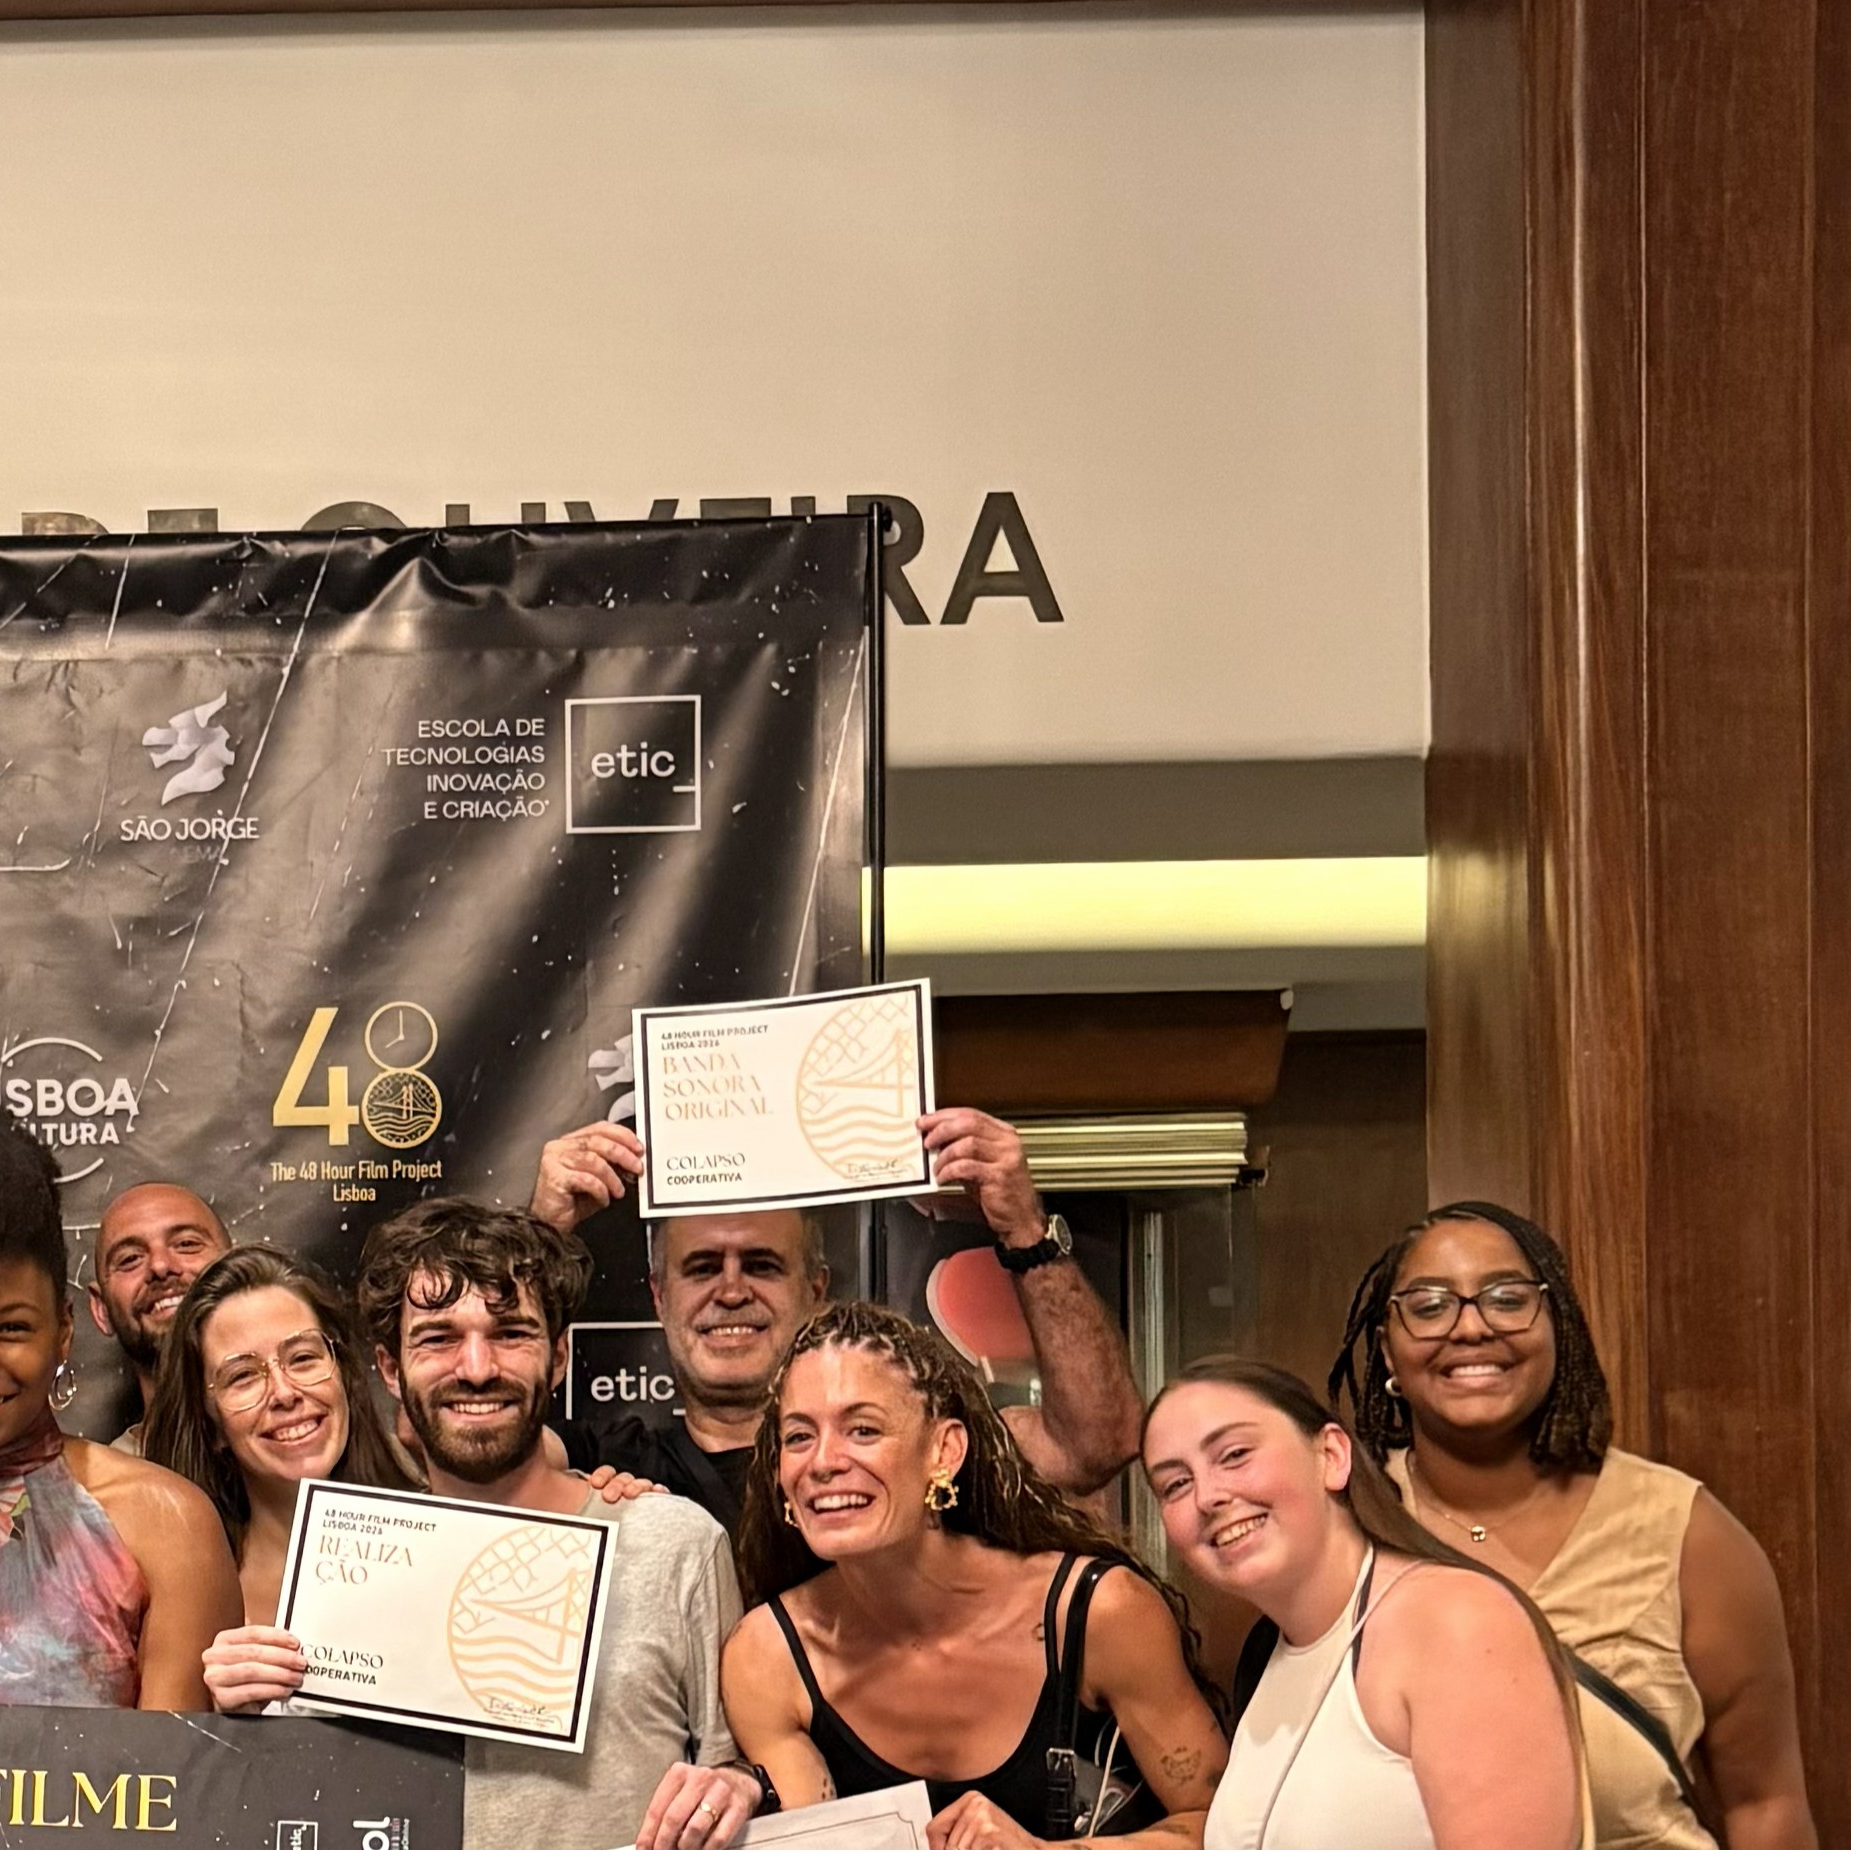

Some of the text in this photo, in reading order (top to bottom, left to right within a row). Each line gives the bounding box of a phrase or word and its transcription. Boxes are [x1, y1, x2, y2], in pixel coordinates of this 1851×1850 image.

[418, 718, 545, 738] ESCOLA DE
[382, 745, 545, 766] TECNOLOGIAS
[591, 741, 675, 778] etic
[427, 769, 545, 794] INOVAÇÃO
[424, 796, 546, 821] E CRIAÇÃO
[120, 815, 260, 841] SÃO JORGE
[663, 1053, 741, 1075] BANDA
[663, 1075, 761, 1098] SONORA
[665, 1097, 773, 1121] ORIGINAL
[29, 1122, 120, 1146] TURA
[270, 1159, 442, 1182] The 48 Hour Film Project
[666, 1152, 746, 1171] COLAPSO
[667, 1172, 742, 1186] COOPERATIVA
[333, 1183, 376, 1202] Lisboa
[591, 1364, 675, 1402] etic
[393, 1518, 437, 1532] PROJECT
[320, 1534, 412, 1567] REALIZA
[315, 1559, 368, 1585] ÇÃO
[300, 1644, 384, 1670] COLAPSO
[305, 1664, 377, 1685] OOPERATIVA
